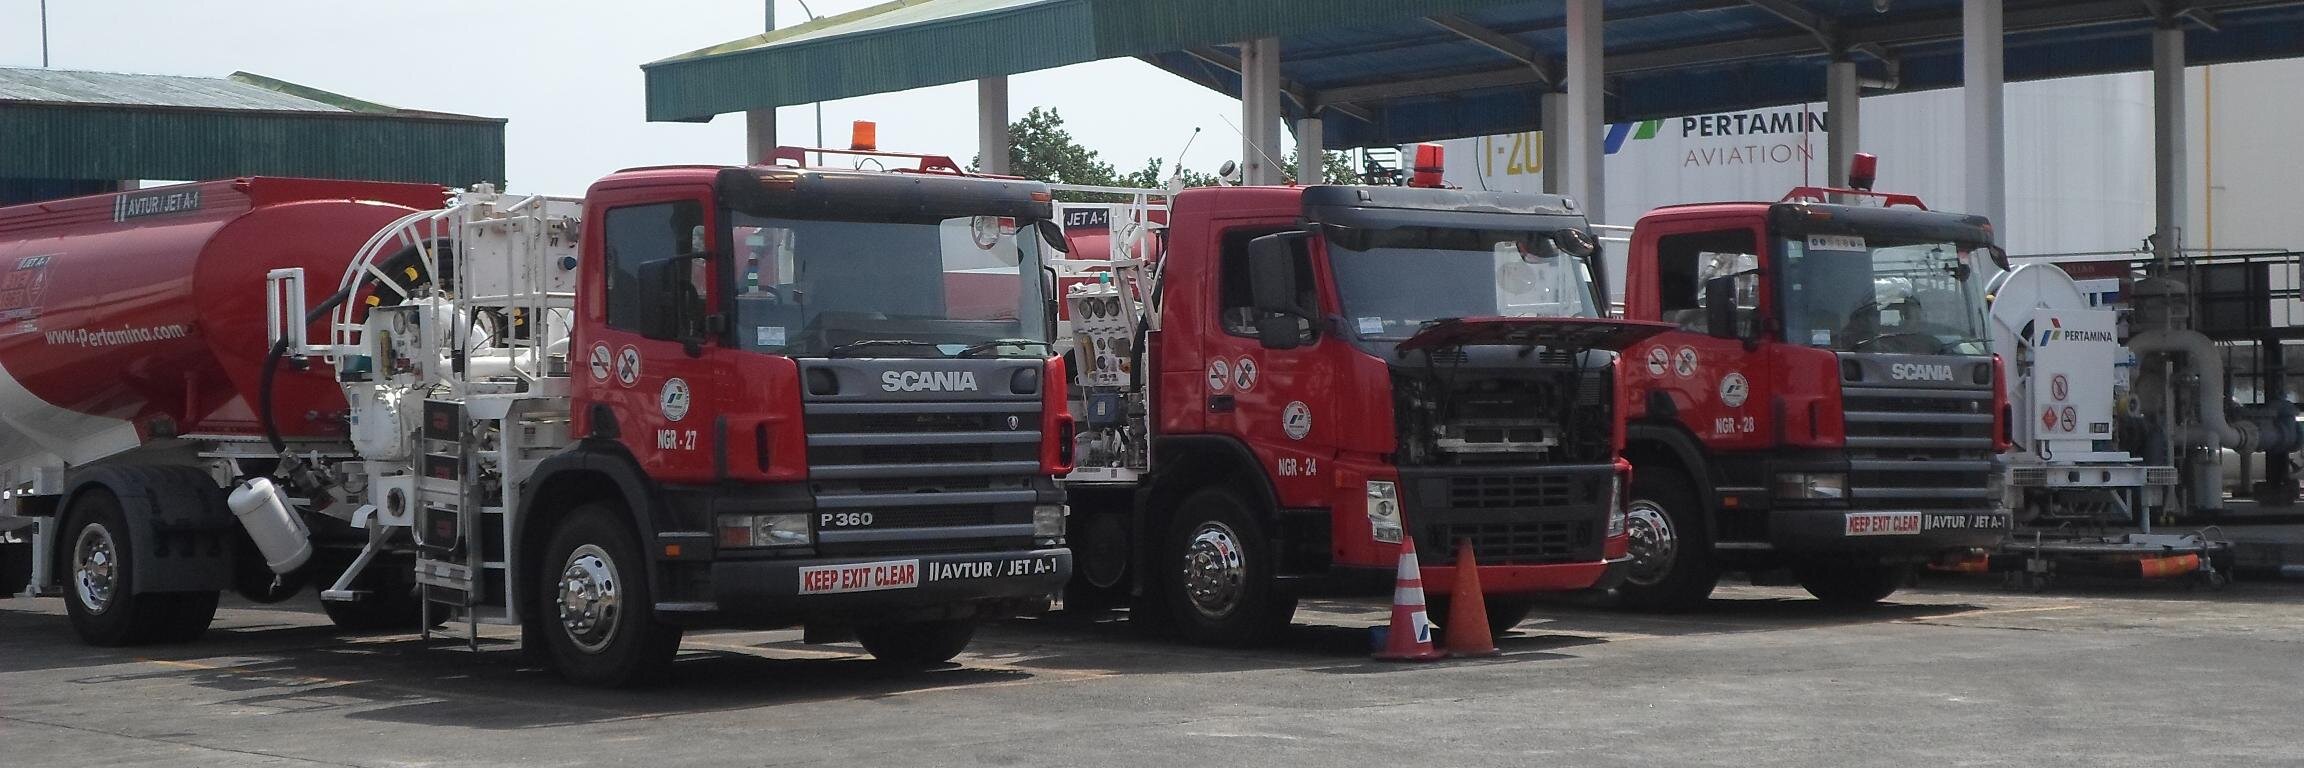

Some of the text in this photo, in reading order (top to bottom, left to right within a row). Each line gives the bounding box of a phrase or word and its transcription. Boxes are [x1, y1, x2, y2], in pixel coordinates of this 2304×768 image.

[1682, 111, 1829, 138] PERTAMIN
[1684, 144, 1815, 168] AVIATION
[164, 193, 183, 212] JET
[182, 191, 199, 209] A-1
[1066, 210, 1109, 226] JET A-1
[45, 323, 186, 347] www.Pertamina.com
[2064, 330, 2113, 343] PERTAMINA
[881, 370, 978, 392] SCANIA
[1892, 363, 1954, 381] SCANIA
[1715, 417, 1736, 434] NGR
[1743, 416, 1755, 433] 28
[657, 429, 678, 450] NGR
[685, 430, 698, 451] 27
[1278, 458, 1298, 477] NGR
[1305, 458, 1317, 477] 24
[835, 512, 874, 527] 360
[1849, 515, 1919, 533] KEEP EXIT CLEAR
[1974, 515, 1991, 529] JET
[1990, 515, 2006, 528] A-1
[1007, 559, 1031, 576] JET
[1033, 557, 1057, 575] A-1
[804, 564, 915, 592] KEEP EXIT CLEAR
